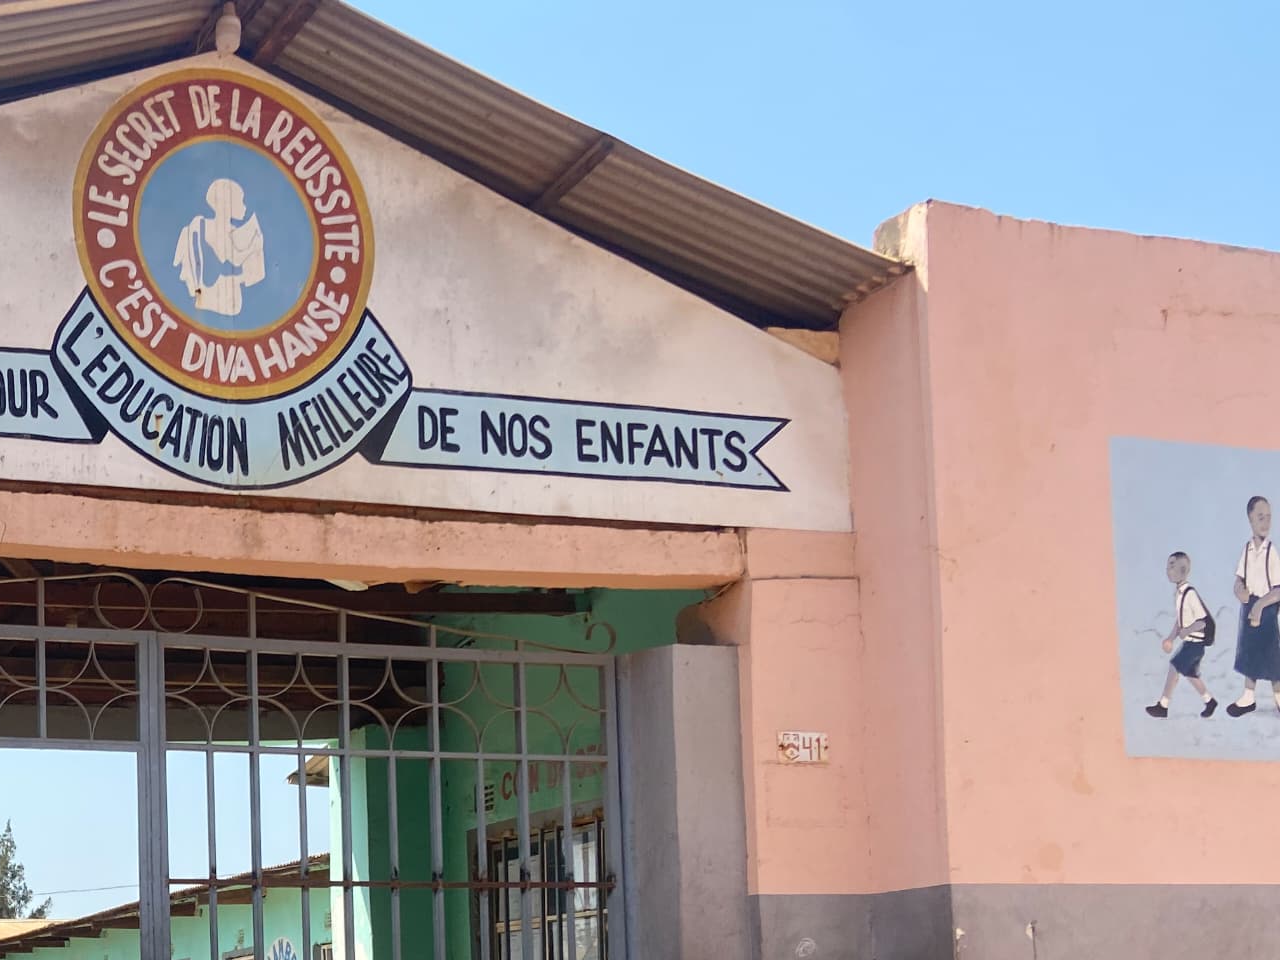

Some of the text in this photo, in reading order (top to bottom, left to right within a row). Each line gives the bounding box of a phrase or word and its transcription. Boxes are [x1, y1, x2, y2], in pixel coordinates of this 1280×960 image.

[87, 84, 360, 265] LE SECRET DE LA REUSSITE
[99, 258, 178, 349] C'EST
[61, 311, 250, 477] L'EDUCATION
[277, 336, 410, 472] MEILLEURE
[417, 404, 461, 454] DE
[480, 409, 553, 460] NOS
[575, 418, 748, 473] ENFANTS
[802, 735, 822, 761] 41
